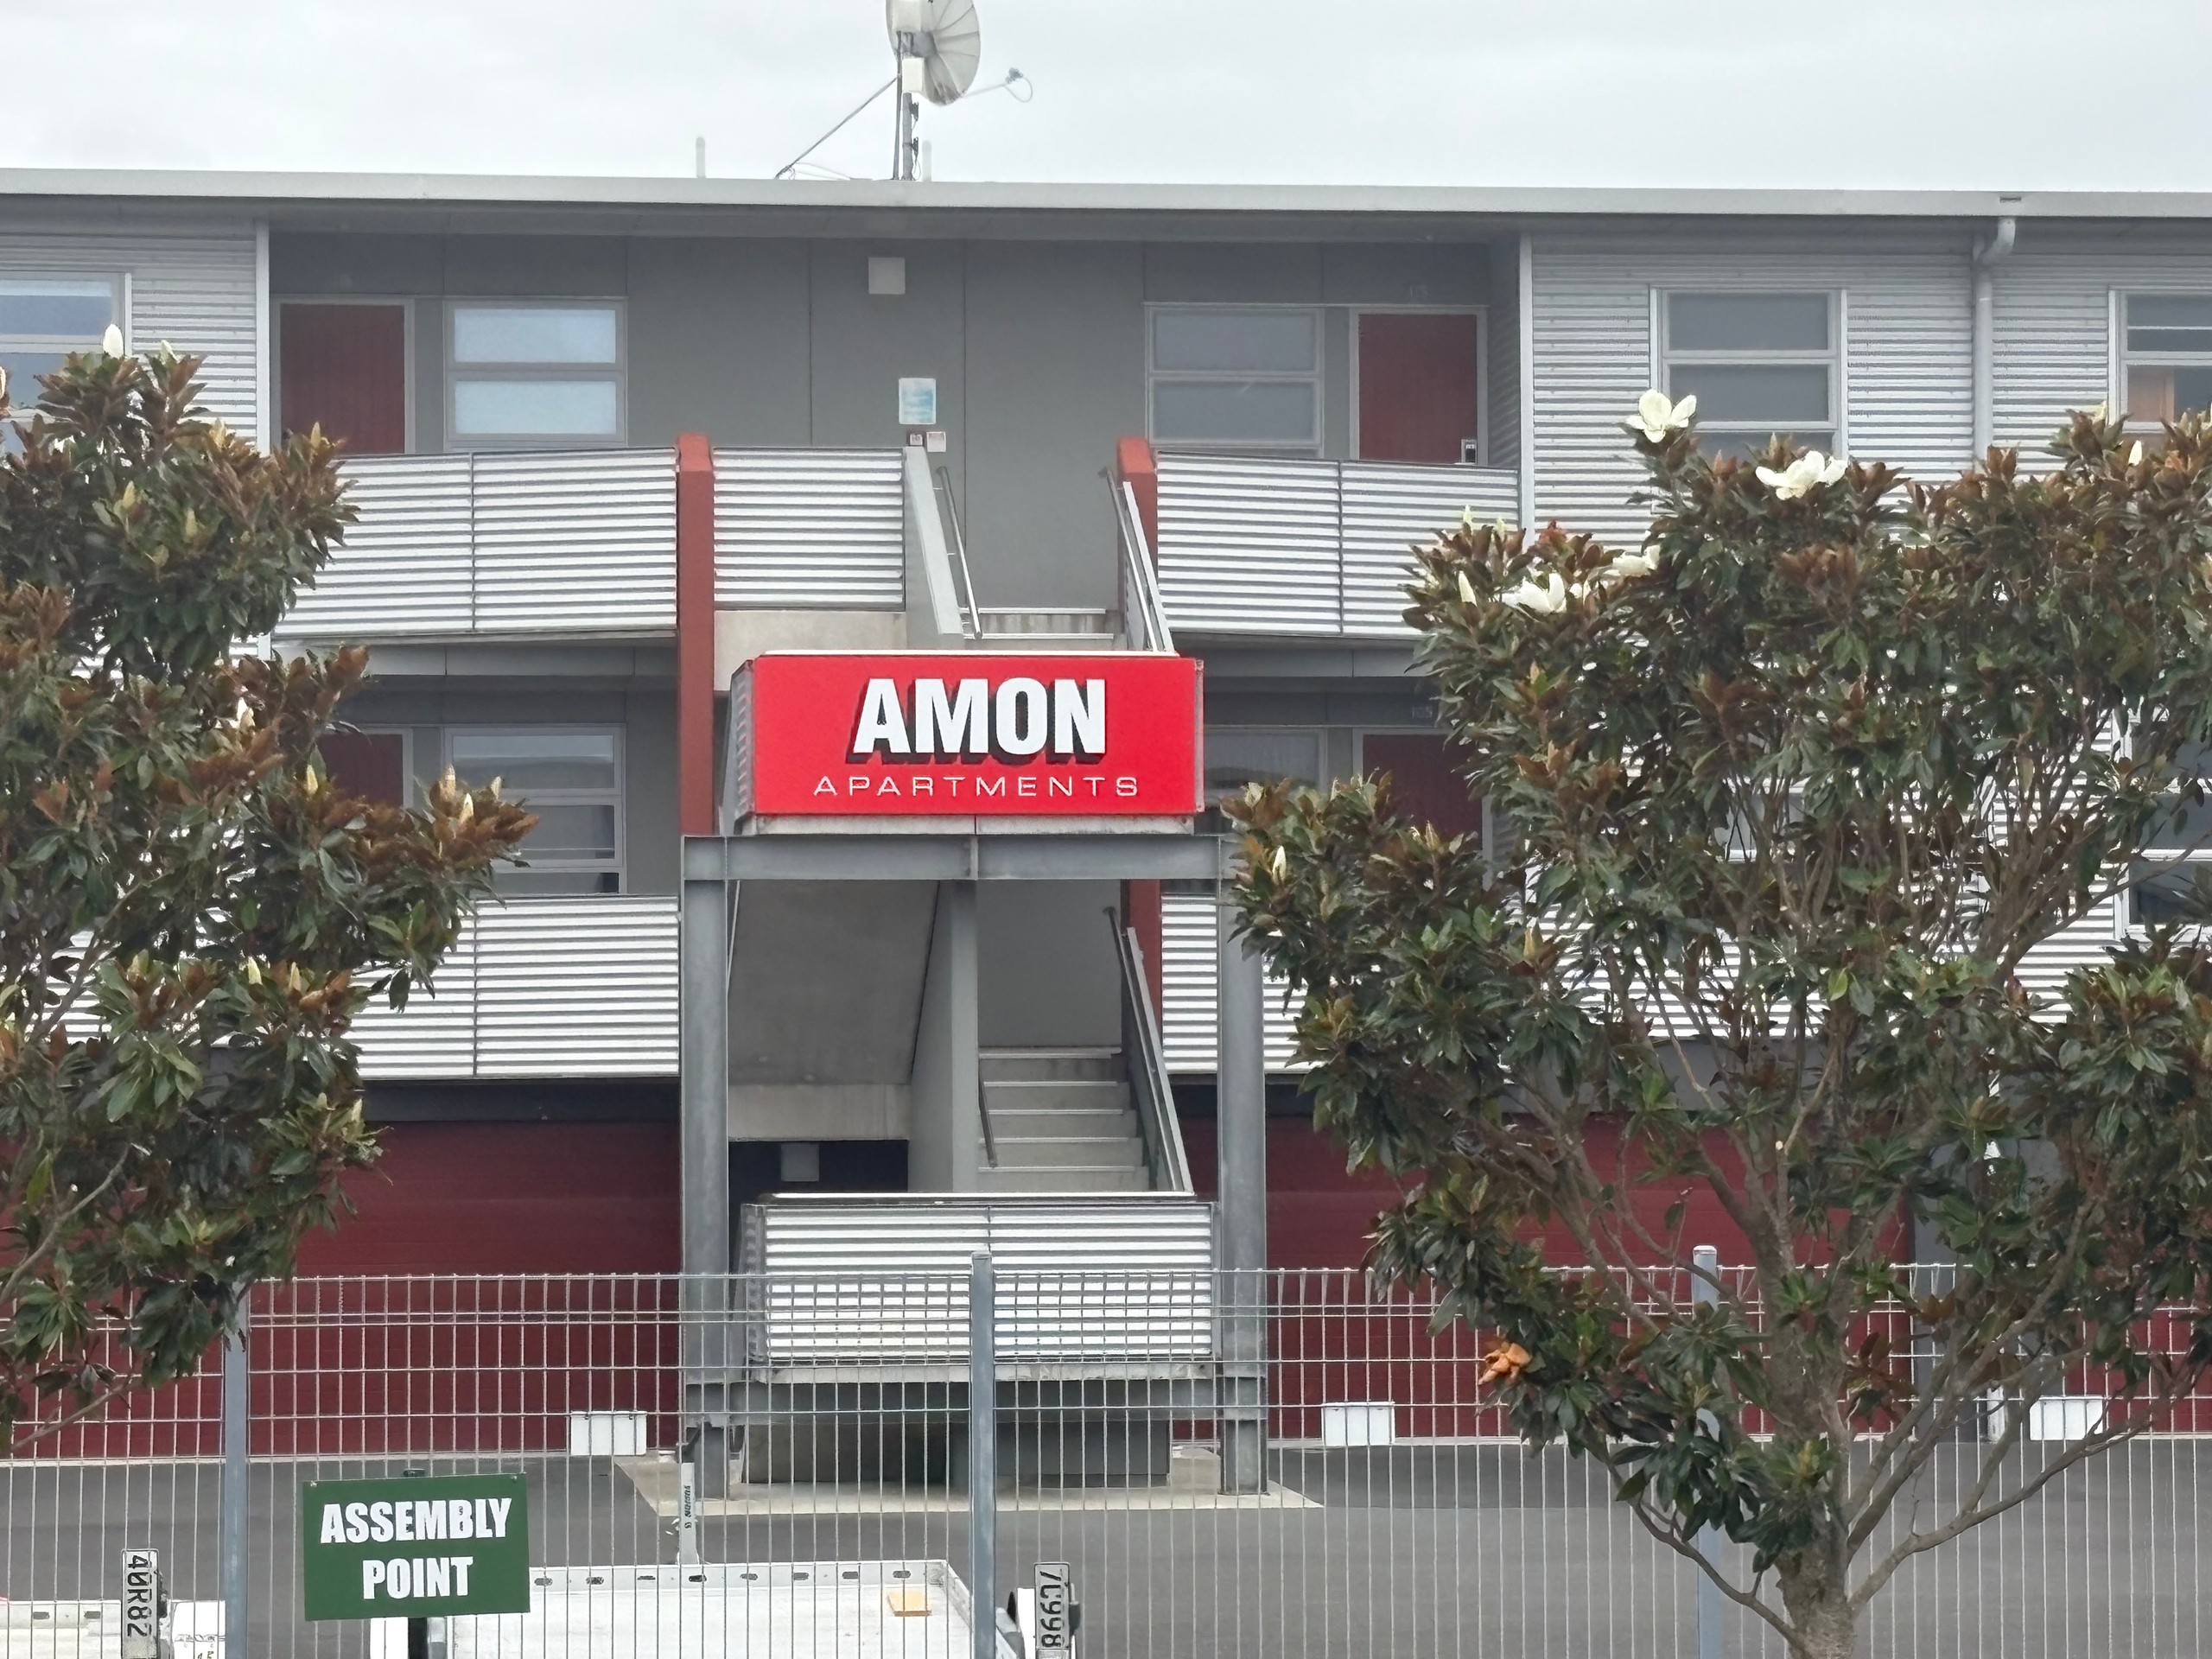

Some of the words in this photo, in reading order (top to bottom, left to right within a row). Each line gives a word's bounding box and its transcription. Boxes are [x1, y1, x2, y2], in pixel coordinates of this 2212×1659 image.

[852, 677, 1106, 756] AMON
[813, 775, 1139, 797] APARTMENTS
[320, 1497, 513, 1544] ASSEMBLY
[362, 1556, 474, 1600] POINT
